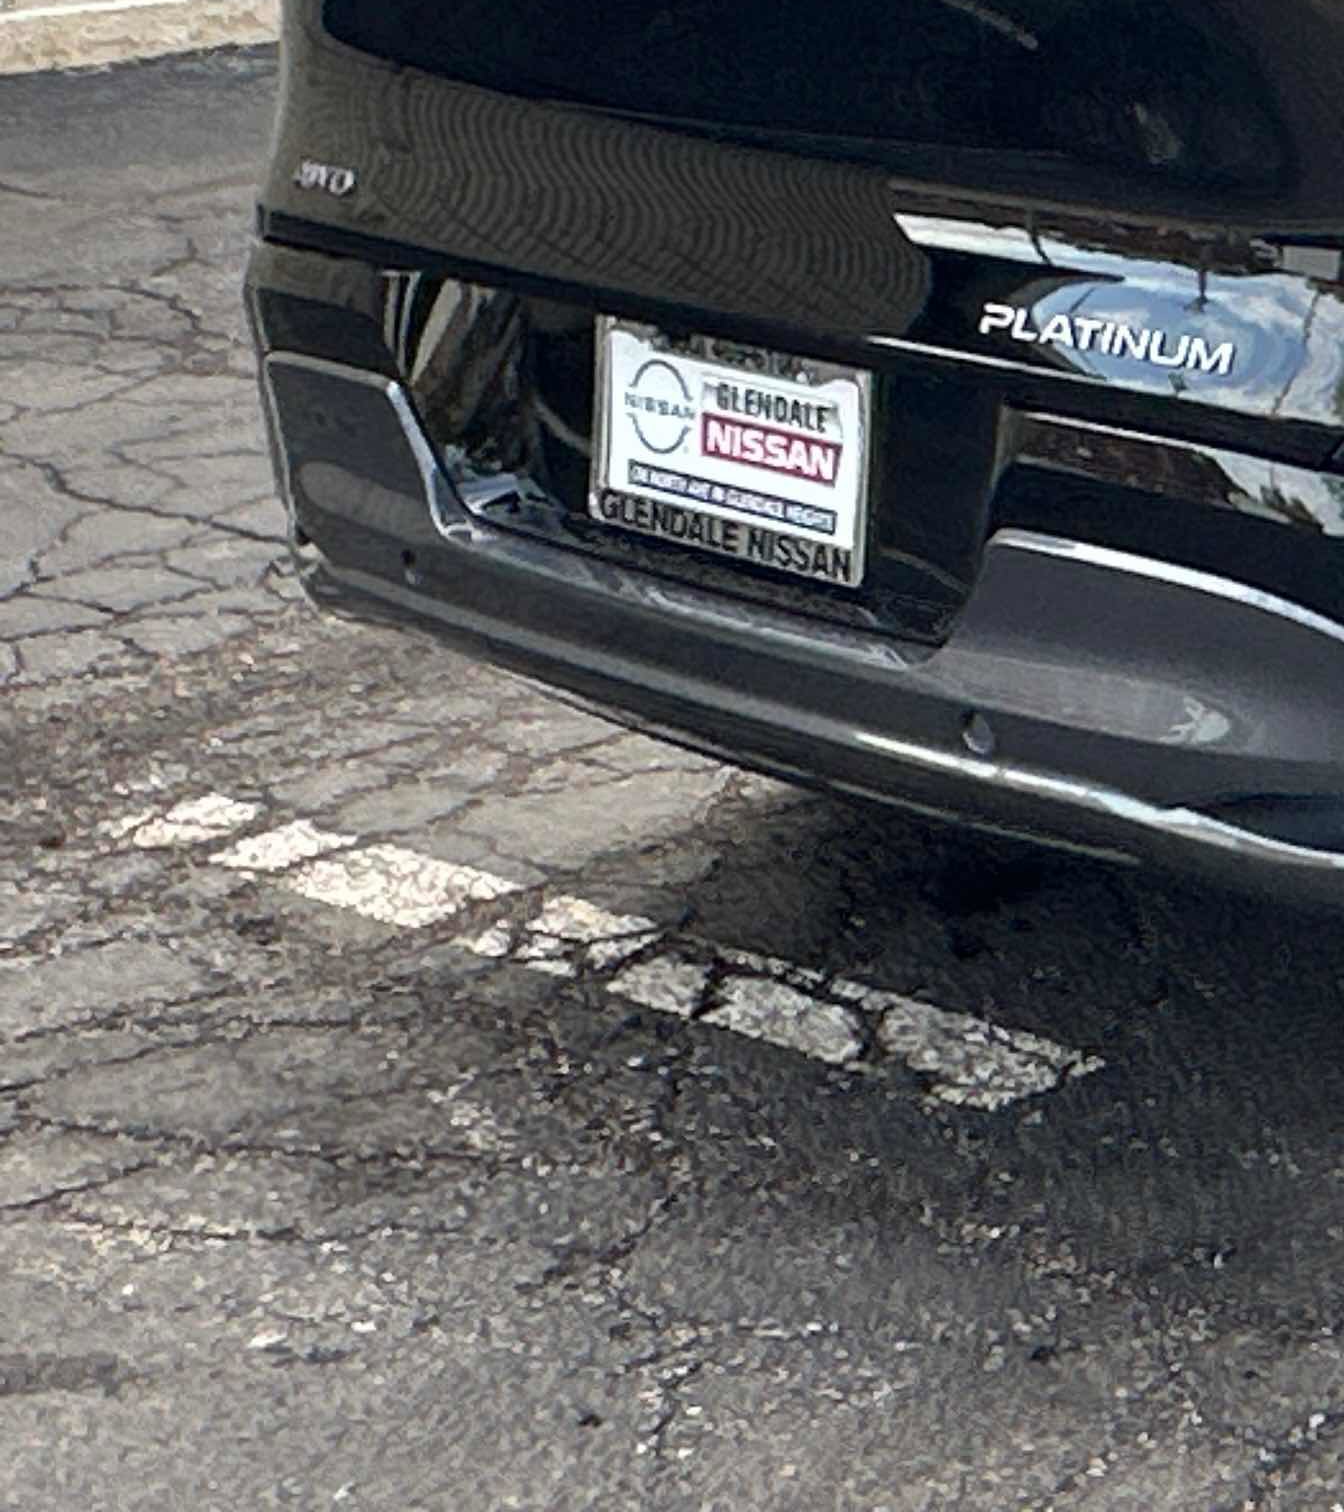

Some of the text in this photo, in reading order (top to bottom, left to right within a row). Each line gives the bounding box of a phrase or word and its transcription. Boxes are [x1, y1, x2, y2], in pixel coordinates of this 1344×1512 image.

[978, 302, 1234, 376] PLATINUM
[624, 392, 696, 420] NISSAN
[716, 382, 828, 434] GLENDALE
[706, 421, 835, 482] NISSAN
[600, 489, 850, 583] GLENDALE NISSAN
